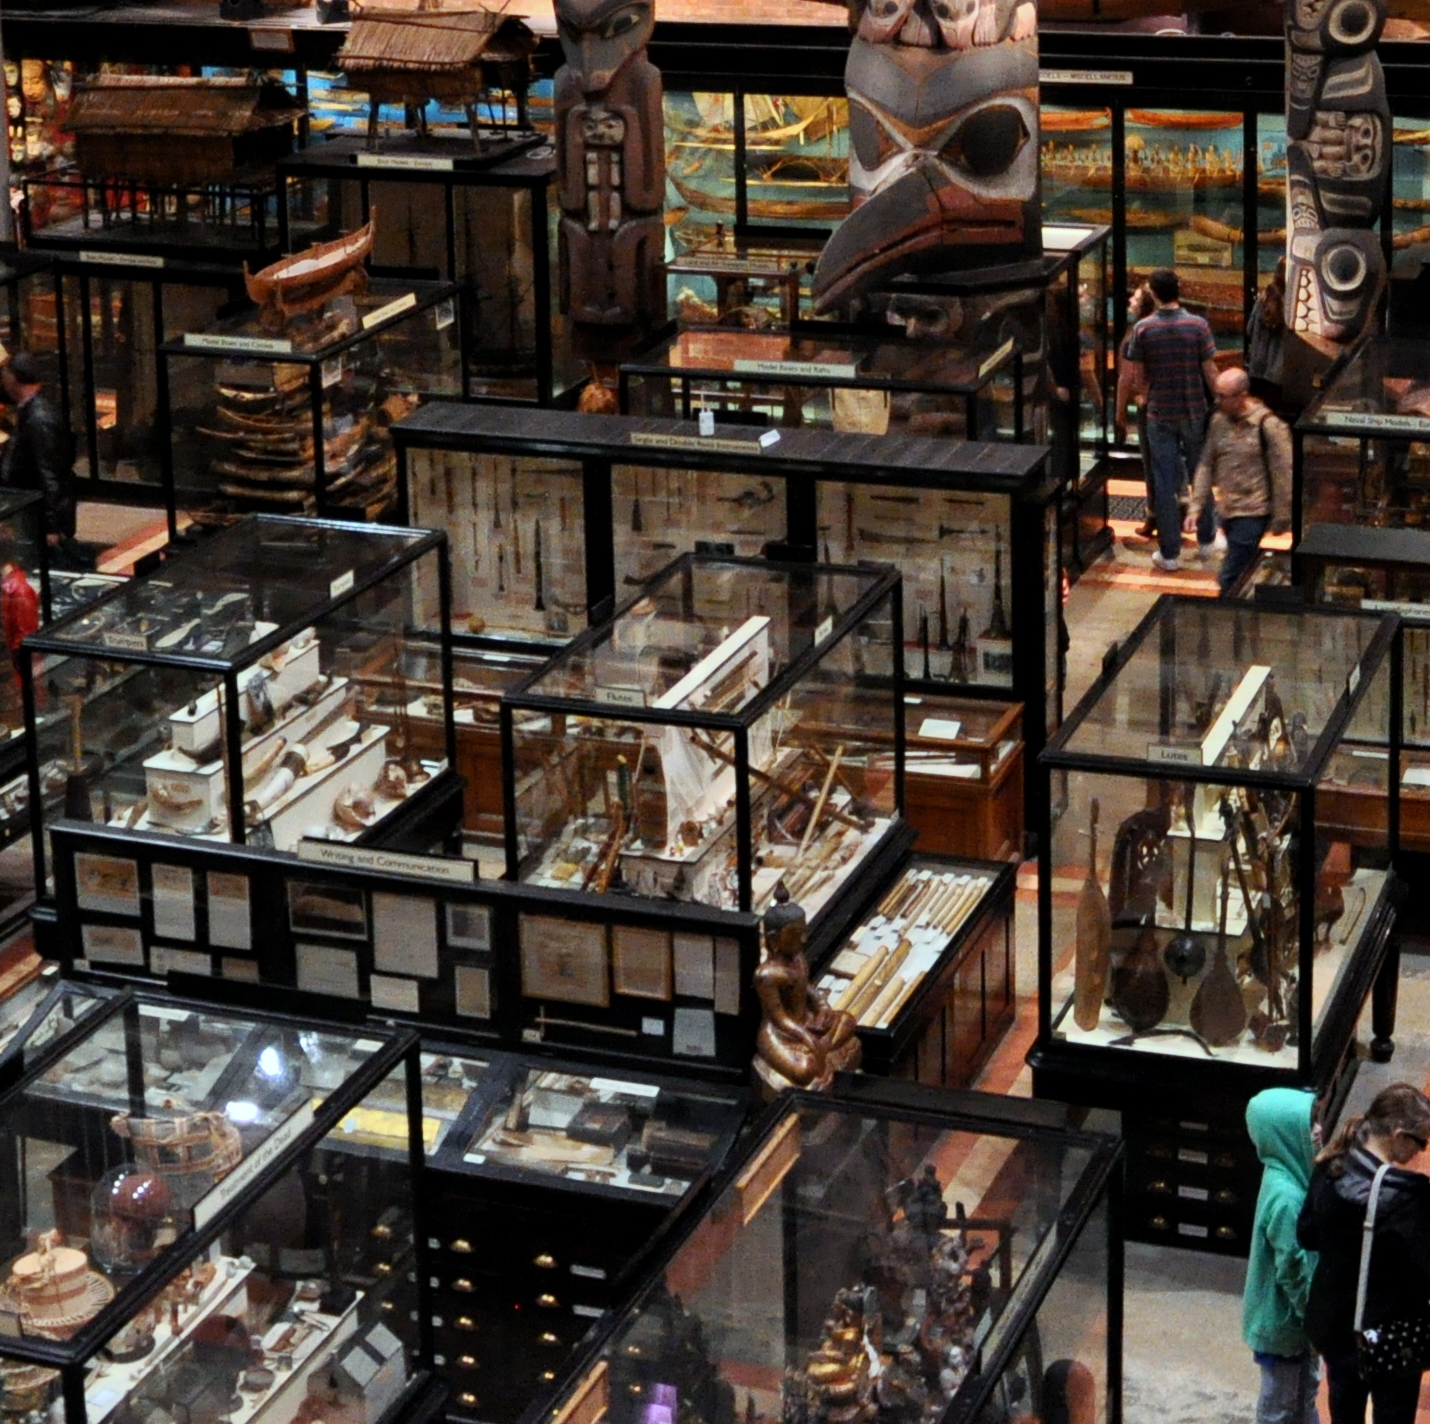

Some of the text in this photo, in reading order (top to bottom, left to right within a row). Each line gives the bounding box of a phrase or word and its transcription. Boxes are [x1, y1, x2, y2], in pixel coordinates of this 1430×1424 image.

[1344, 415, 1366, 424] Naval
[1367, 417, 1383, 427] Ship
[606, 692, 633, 703] Flutes
[1160, 749, 1188, 761] Lutes
[320, 848, 450, 875] Writing and Communication
